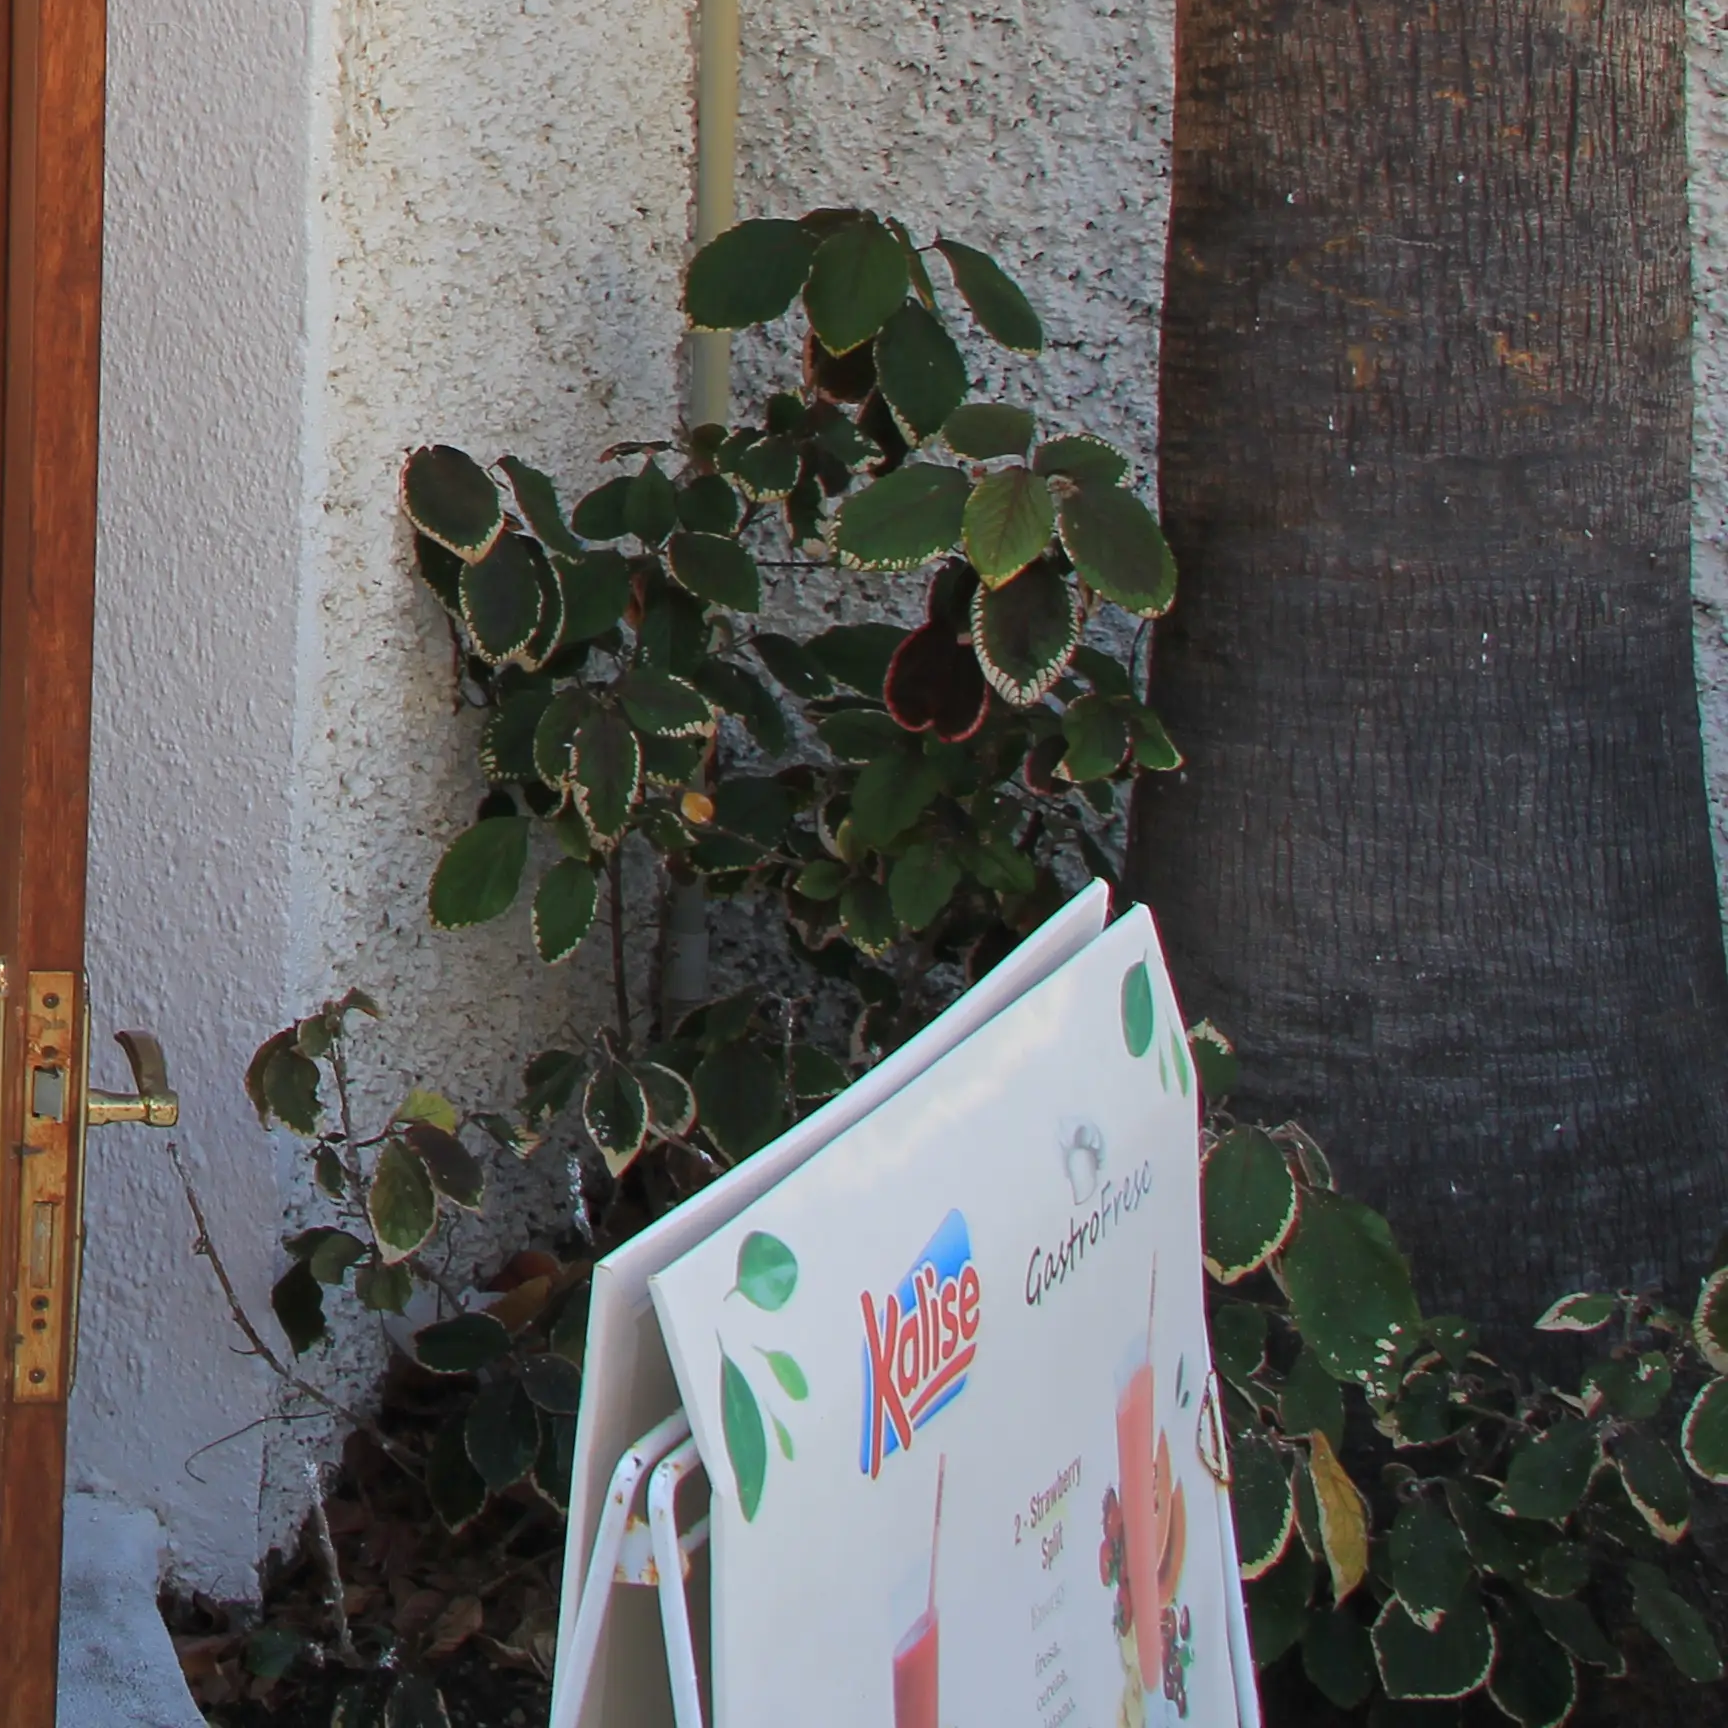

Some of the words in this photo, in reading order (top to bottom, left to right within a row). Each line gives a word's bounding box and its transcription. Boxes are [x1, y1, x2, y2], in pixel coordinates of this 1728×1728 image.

[859, 1264, 981, 1481] Kalise
[1013, 1513, 1022, 1546] 2
[1029, 1454, 1082, 1529] Strawberry
[1041, 1519, 1064, 1570] Split
